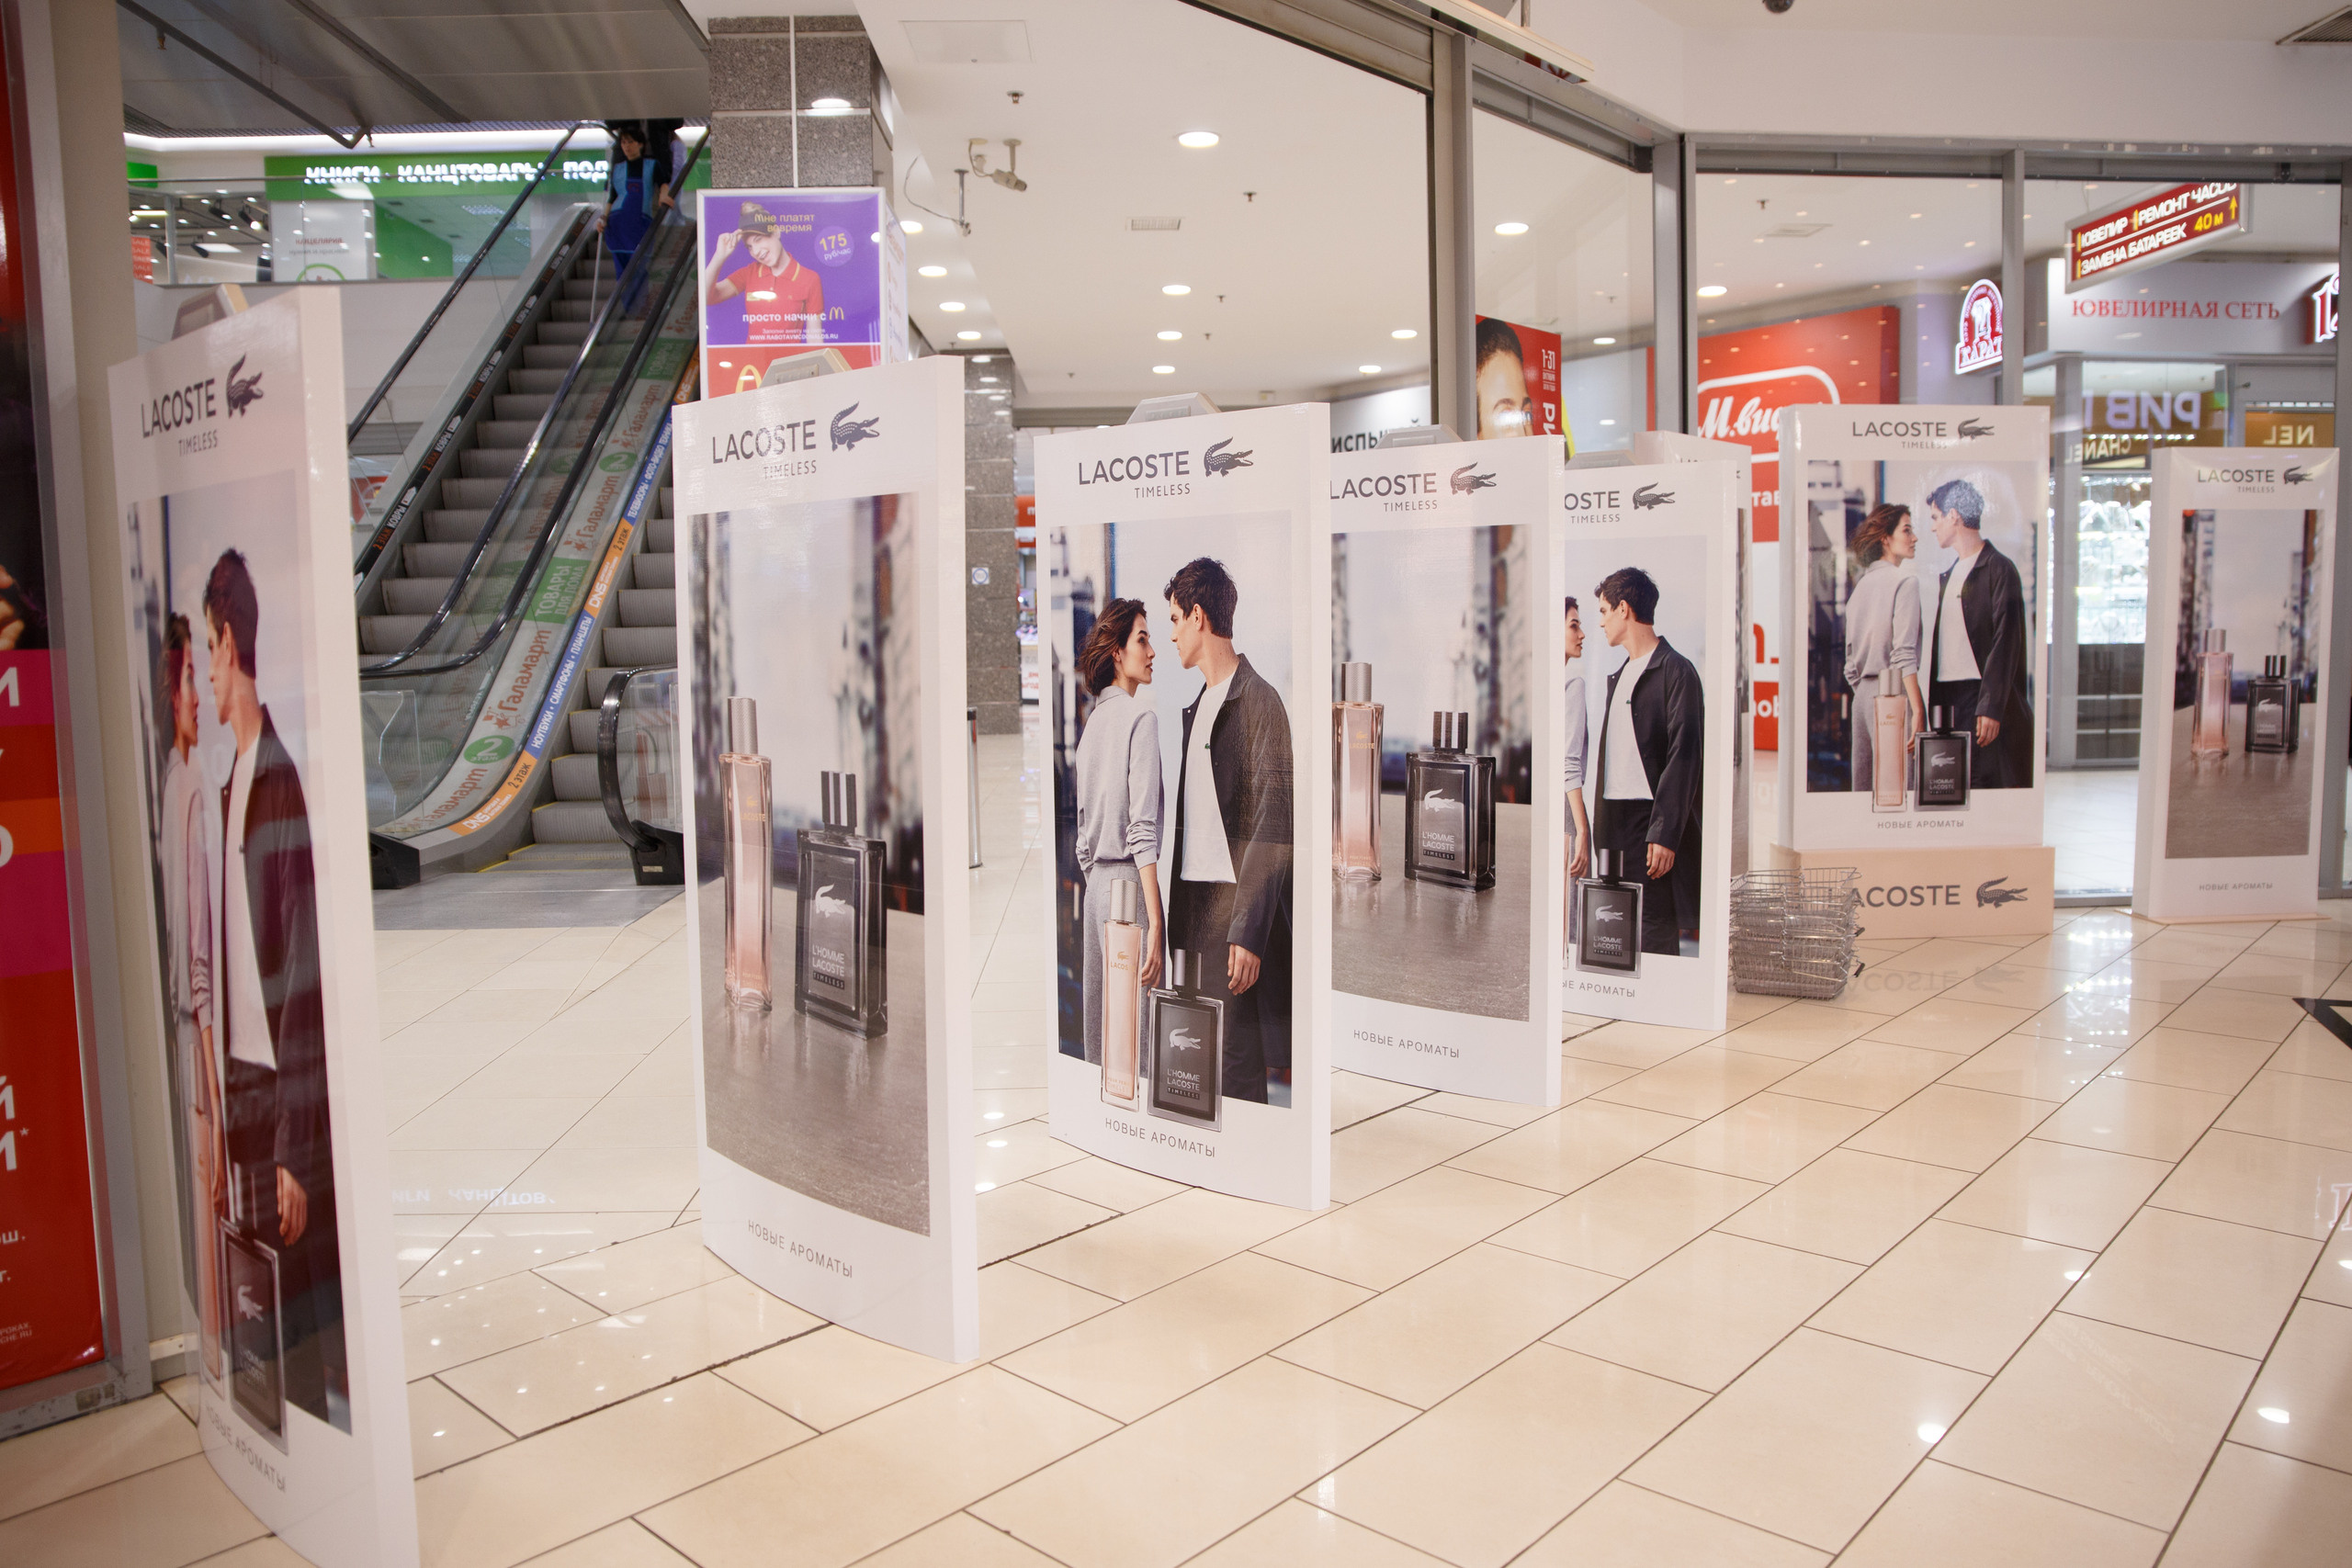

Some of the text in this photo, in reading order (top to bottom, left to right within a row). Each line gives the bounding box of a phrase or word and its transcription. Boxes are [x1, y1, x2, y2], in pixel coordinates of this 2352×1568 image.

[304, 165, 380, 184] КНИГИ
[767, 224, 812, 233] вовремя
[780, 214, 815, 223] платят
[2081, 217, 2128, 248] ЮВЕЛИР
[2138, 192, 2190, 226] РЕМОНТ
[820, 233, 847, 251] 175
[2081, 247, 2127, 276] ЗАМЕНА
[2128, 222, 2187, 258] БАТАРЕЕК
[2194, 212, 2212, 231] 40
[824, 248, 852, 261] руб/час
[742, 313, 781, 323] просто
[784, 313, 817, 321] начни
[2072, 299, 2279, 320] ЮВЕЛИРНАЯ СЕТЬ
[141, 378, 216, 438] LACOSTE
[1698, 396, 1780, 441] М.ви
[1852, 421, 1947, 437] LACOSTE
[178, 429, 218, 457] TIMELESS
[712, 419, 816, 464] LACOSTE
[1902, 441, 1947, 449] TIMELESS
[763, 459, 817, 479] TIMELESS
[1079, 450, 1190, 485] LACOSTE
[2198, 469, 2275, 483] LACOSTE
[1135, 483, 1191, 499] TIMELESS
[1330, 472, 1437, 500] LACOSTE
[577, 474, 620, 539] Галамарт
[627, 482, 649, 519] ТЕЛЕВИЗОРЫ
[1384, 500, 1438, 513] TIMELESS
[386, 504, 406, 530] КОВРЫ
[1571, 513, 1621, 524] TIMELESS
[535, 565, 572, 617] ТОВАРЫ
[588, 581, 607, 608] DNS
[497, 629, 552, 712] Галамарт
[531, 616, 594, 749] НОУТБУКИ СМАРТФОНЫ ПЛАНШЕТЫ
[479, 739, 499, 759] 2
[507, 761, 532, 789] 2 этаж
[462, 812, 491, 829] DNS
[1878, 819, 1964, 829] НОВЫЕ АРОМАТЫ
[1422, 831, 1454, 842] L'HOMME
[1422, 840, 1454, 852] LACOSTE
[1423, 851, 1454, 861] TIMELESS
[1593, 936, 1623, 944] L'HOMME
[1593, 942, 1623, 951] LACOSTE
[812, 944, 845, 964] L'HOMME
[812, 956, 845, 977] LACOSTE
[1579, 981, 1635, 998] АРОМАТЫ
[1353, 1029, 1459, 1058] НОВЫЕ АРОМАТЫ
[1167, 1068, 1200, 1082] L'HOMME
[1167, 1078, 1200, 1091] LACOSTE
[1167, 1087, 1200, 1100] TIMELESS
[1105, 1118, 1216, 1158] НОВЫЕ АРОМАТЫ
[748, 1220, 853, 1279] НОВЫЕ АРОМАТЫ
[236, 1437, 286, 1493] АРОМАТЫ
